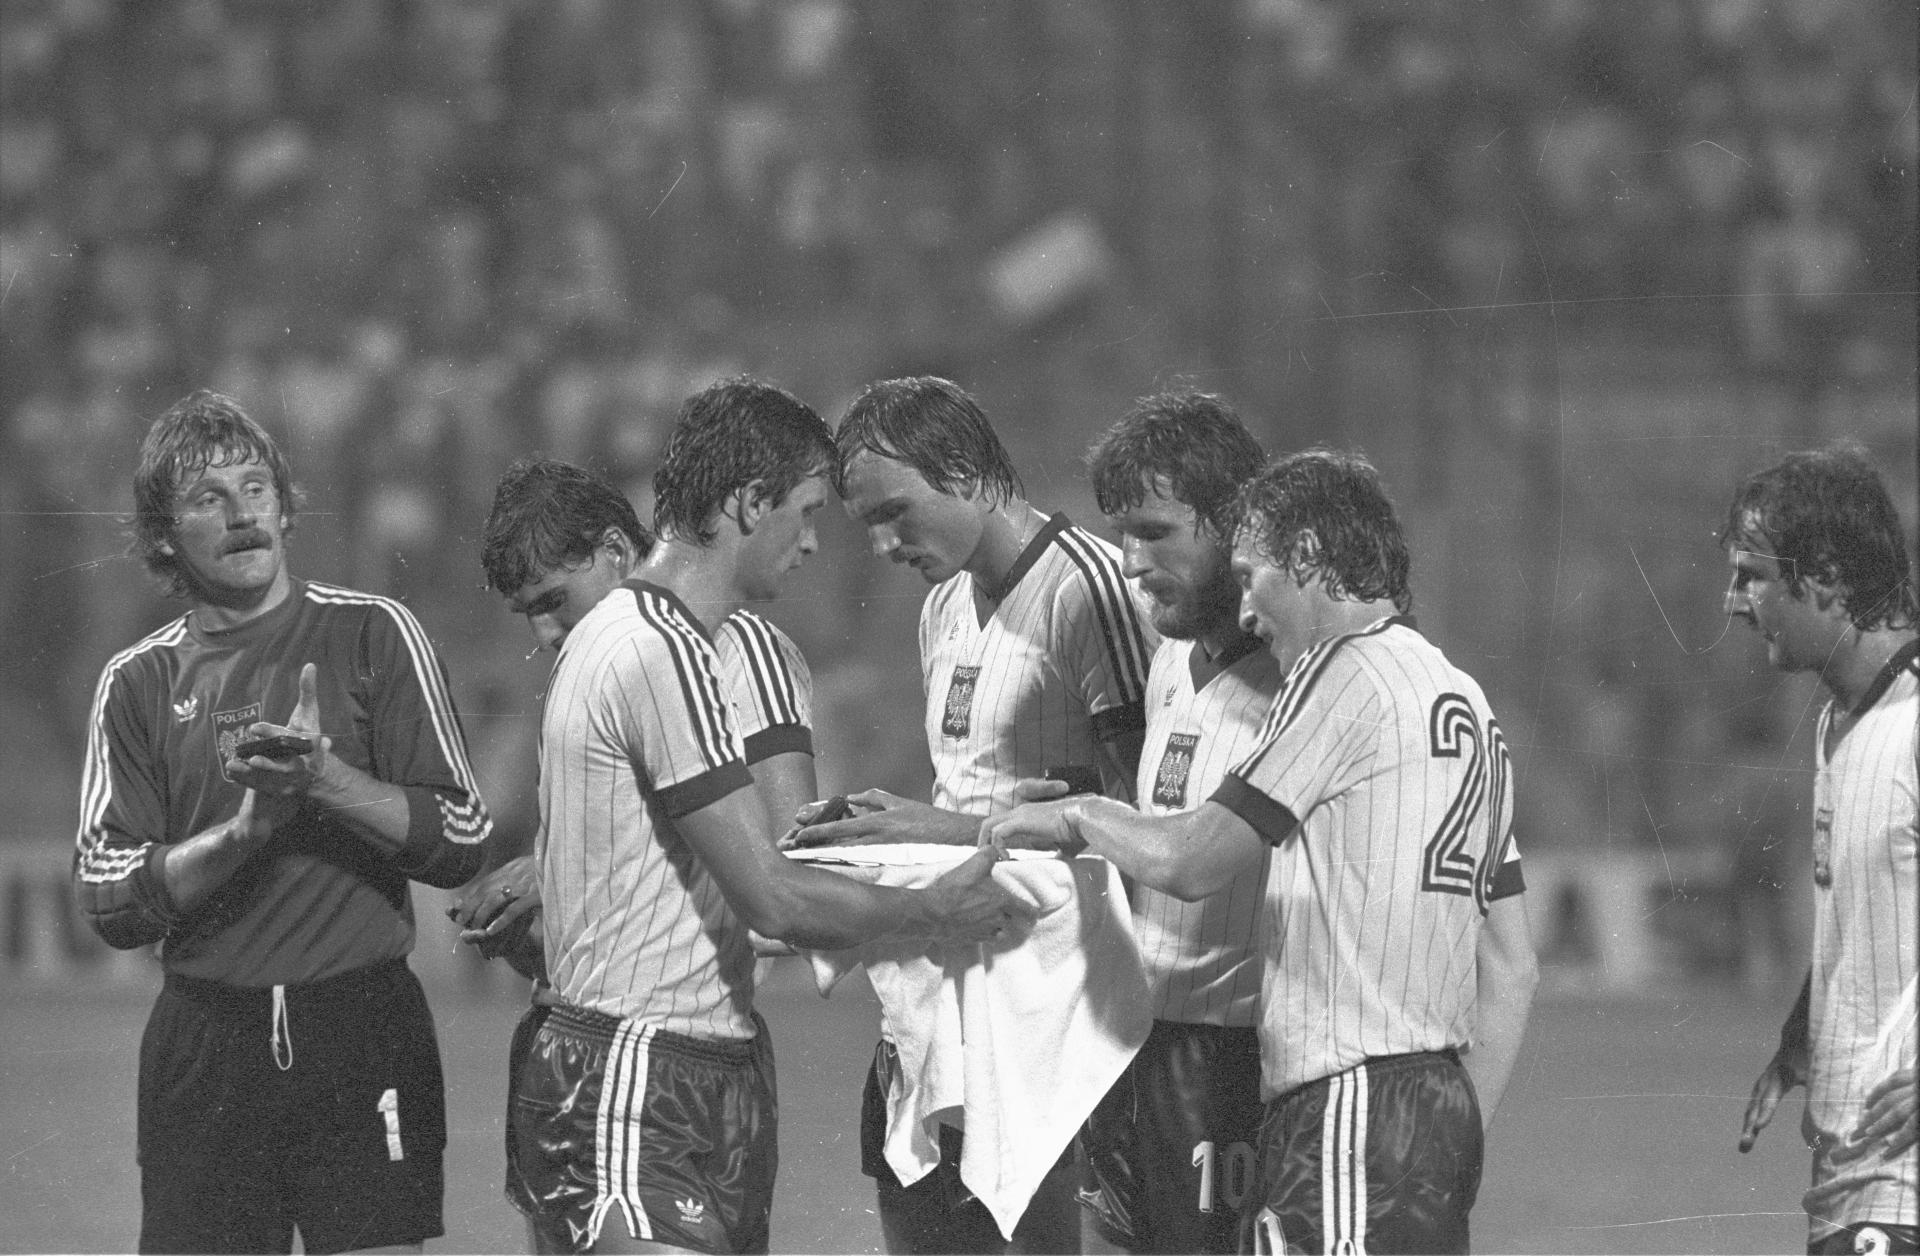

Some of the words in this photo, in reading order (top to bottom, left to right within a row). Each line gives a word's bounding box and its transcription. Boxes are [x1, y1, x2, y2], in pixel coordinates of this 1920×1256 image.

[216, 708, 257, 725] POLSKA
[1169, 734, 1195, 747] POLSKA
[377, 1088, 404, 1161] 1
[1192, 1141, 1256, 1212] 10
